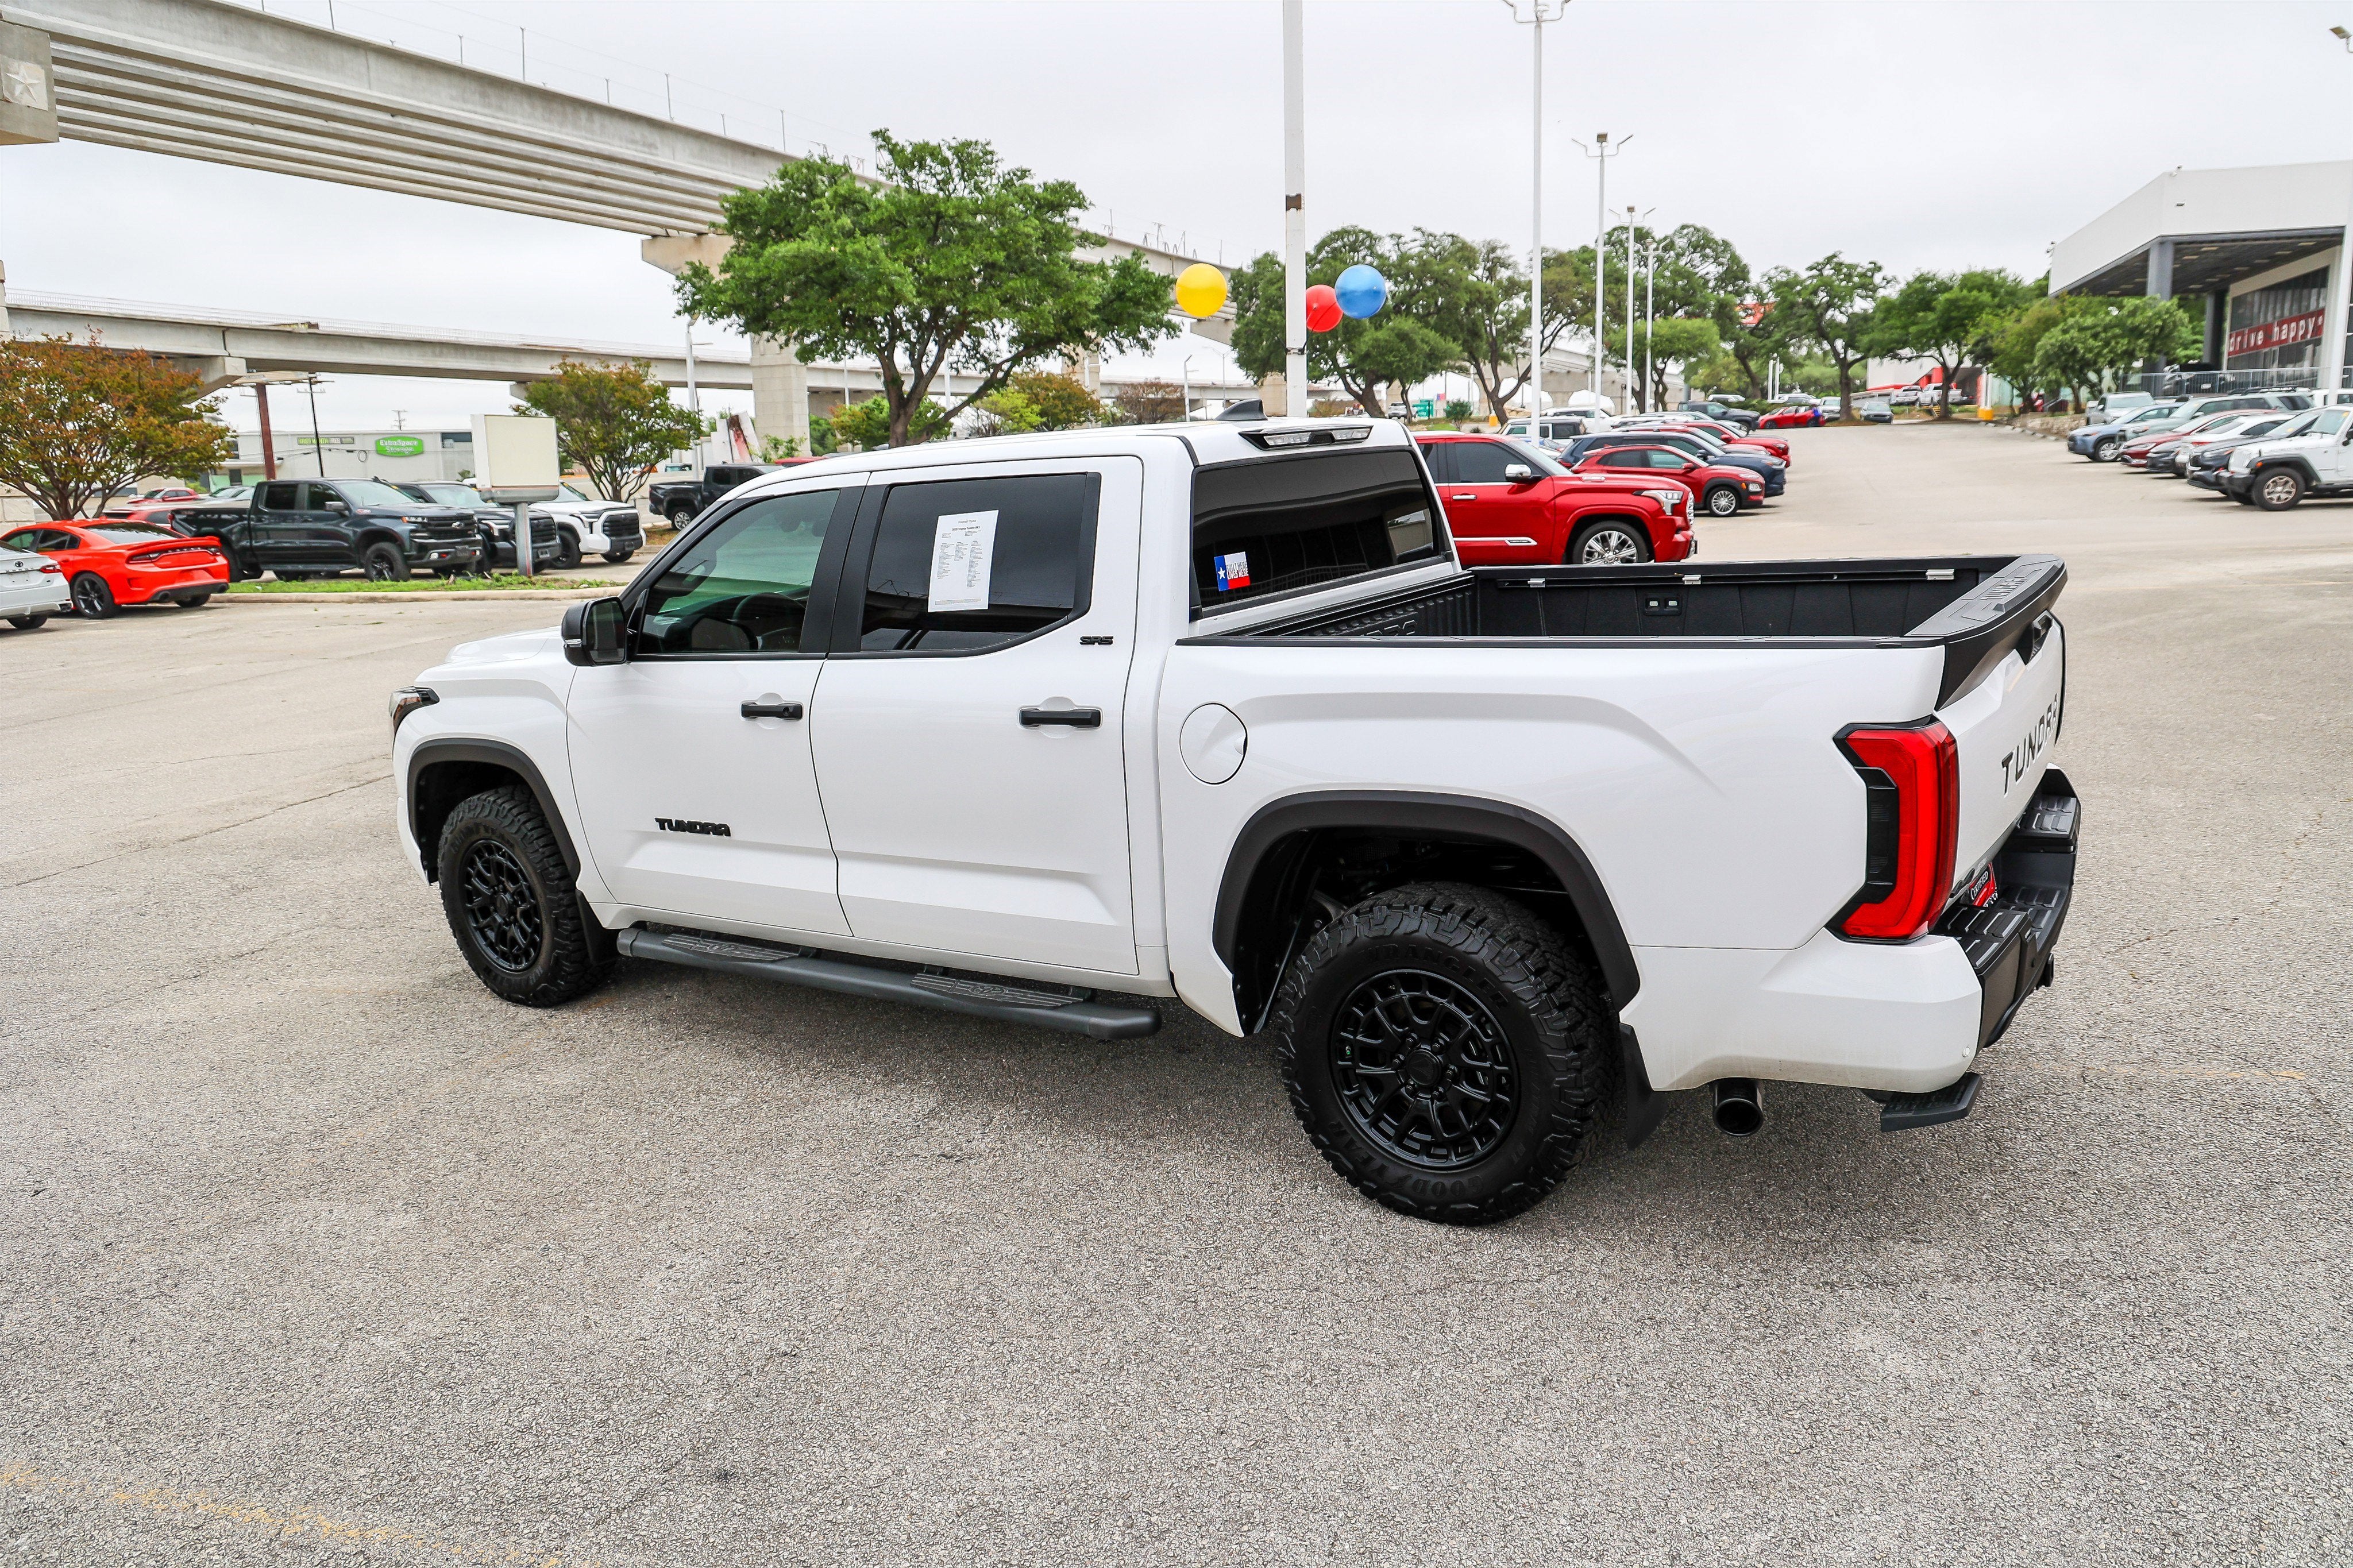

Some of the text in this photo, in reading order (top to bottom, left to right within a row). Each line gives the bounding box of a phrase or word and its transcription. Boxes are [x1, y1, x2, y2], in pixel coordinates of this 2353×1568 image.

[2229, 317, 2316, 352] drive happy
[385, 446, 414, 455] Storage
[1237, 561, 1248, 570] HERE
[1227, 568, 1249, 580] LIVES HERE
[1079, 636, 1114, 646] SR5
[654, 817, 731, 837] TUNDRA
[1970, 871, 1989, 901] CERTIFIED
[1356, 944, 1509, 1010] WRANGLER
